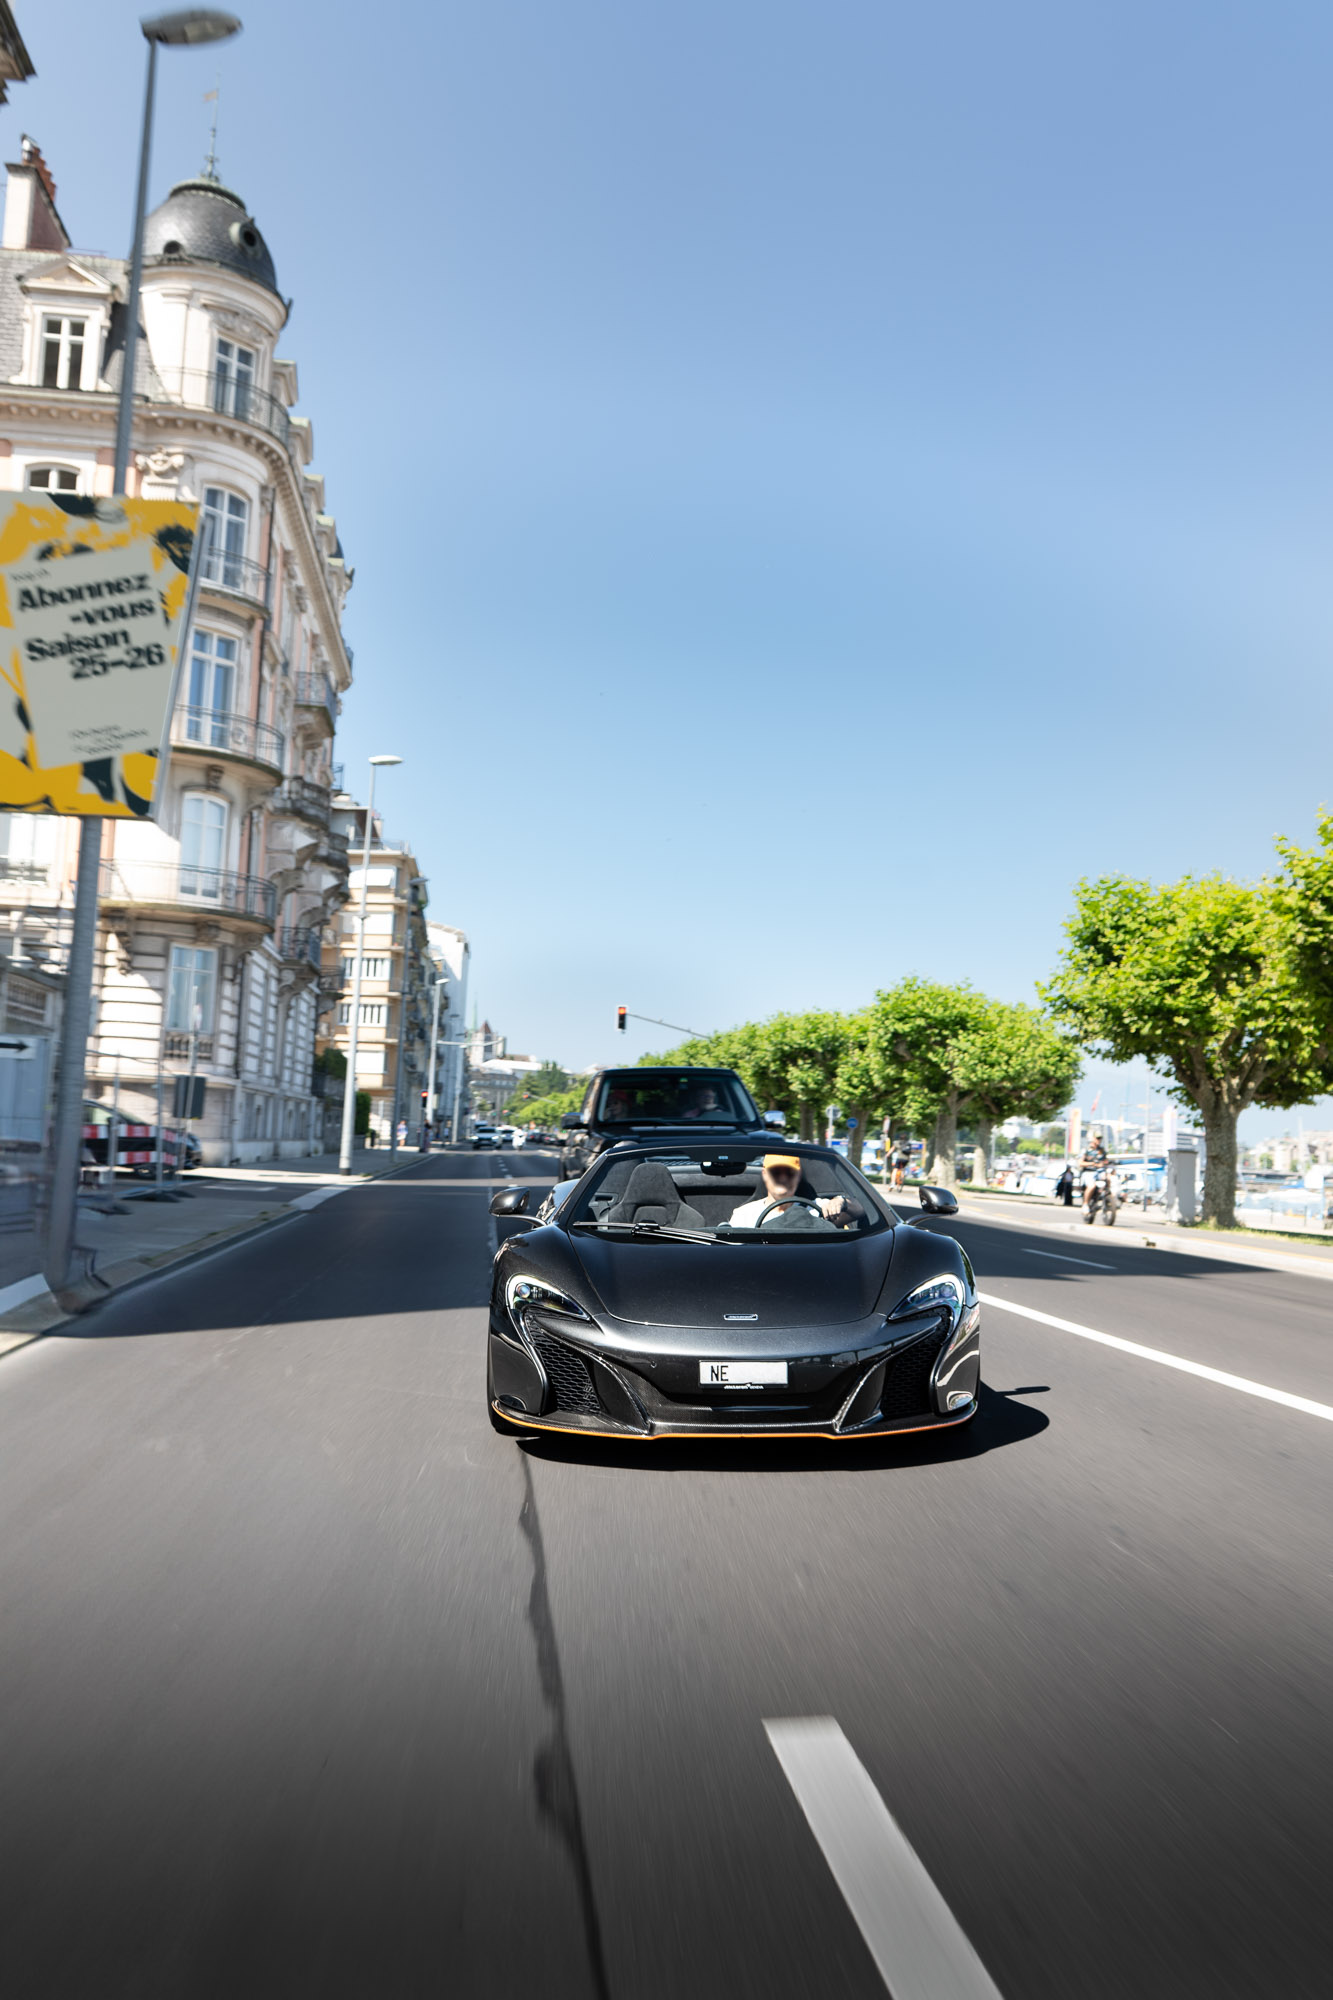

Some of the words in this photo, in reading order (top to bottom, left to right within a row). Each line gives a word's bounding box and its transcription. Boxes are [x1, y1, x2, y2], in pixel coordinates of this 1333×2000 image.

[19, 574, 149, 611] Abonnez
[70, 599, 155, 624] -vous
[26, 630, 129, 661] Saison
[711, 1366, 728, 1381] NE
